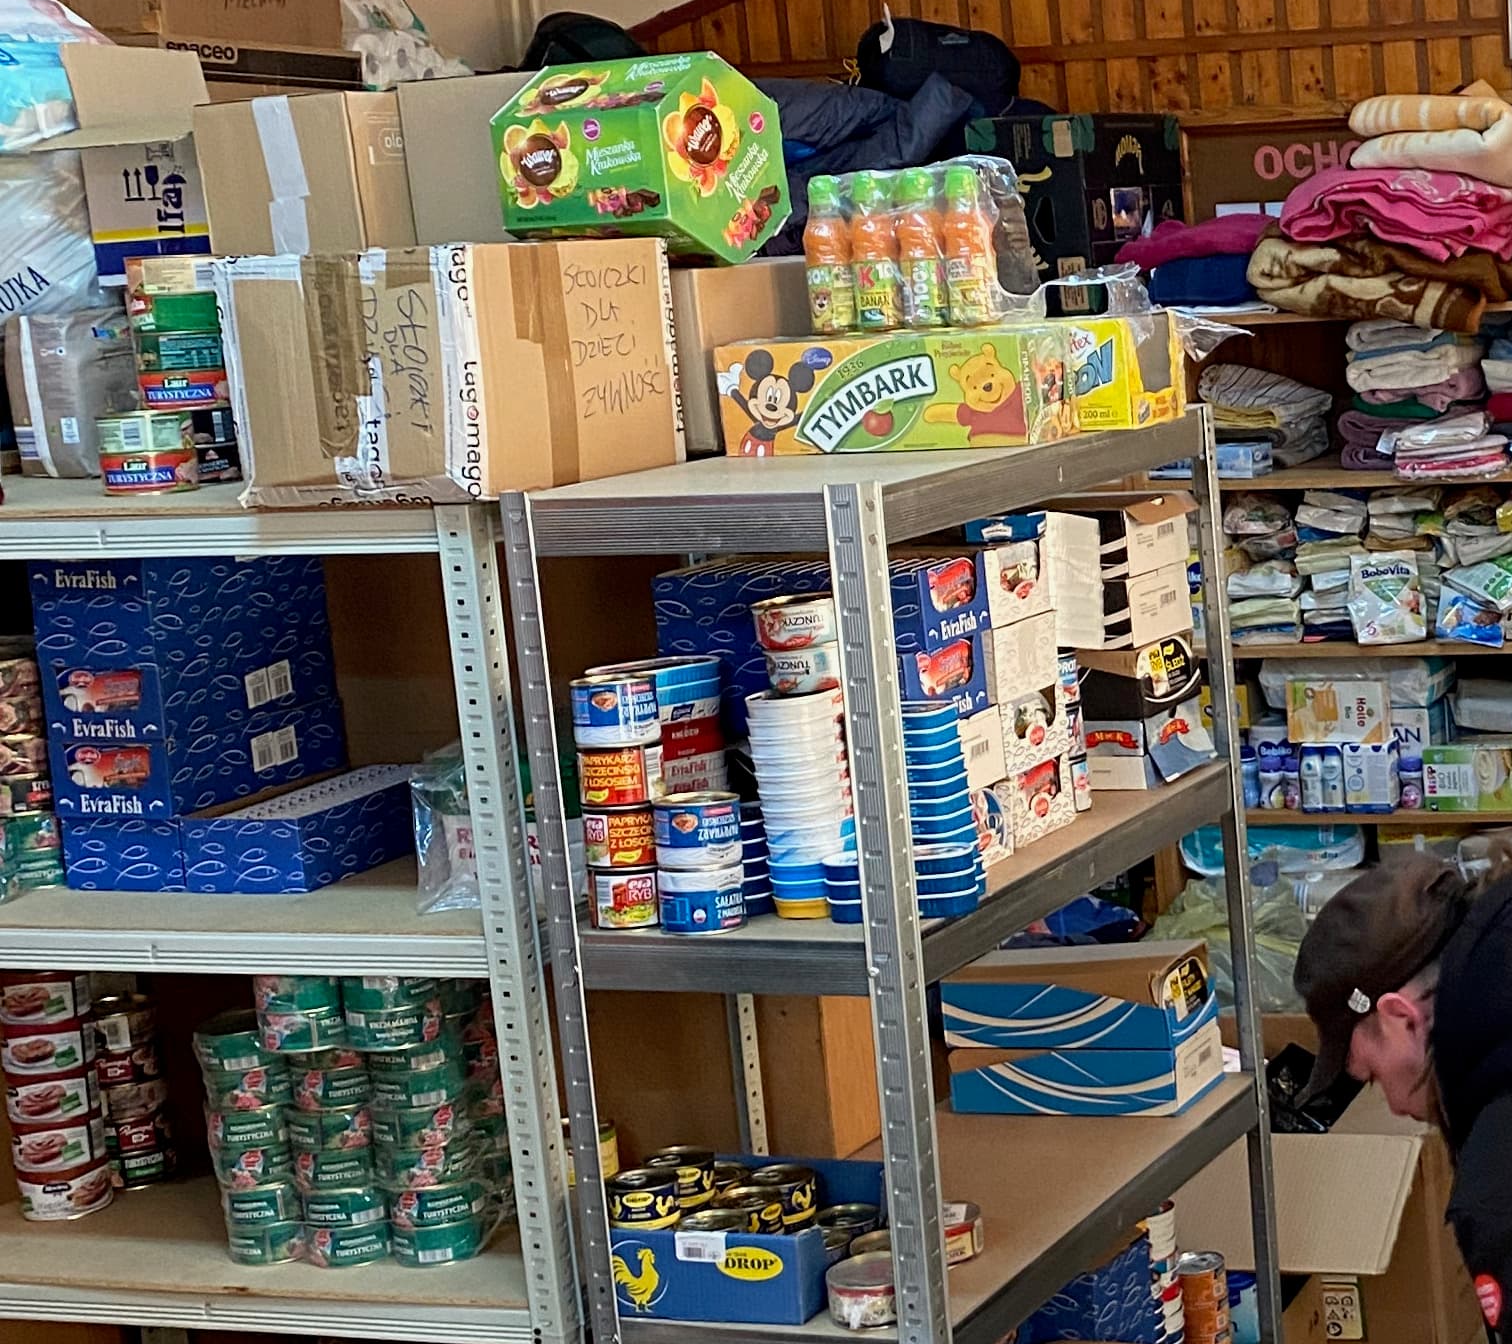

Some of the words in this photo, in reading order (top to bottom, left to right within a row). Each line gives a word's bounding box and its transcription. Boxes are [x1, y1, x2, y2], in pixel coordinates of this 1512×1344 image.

[837, 359, 865, 380] 1936
[145, 387, 213, 402] TURYSTYCZNA
[811, 362, 928, 441] TYMBARK
[106, 468, 173, 485] TURYSTYCZNA
[55, 568, 117, 590] EvraFish
[1361, 564, 1411, 580] BoboVita
[940, 610, 978, 642] EvraFish
[1356, 697, 1367, 728] Holle
[72, 719, 136, 739] EvraFish
[80, 794, 143, 815] EvraFish
[628, 887, 653, 901] RYB
[724, 1256, 776, 1271] DROP
